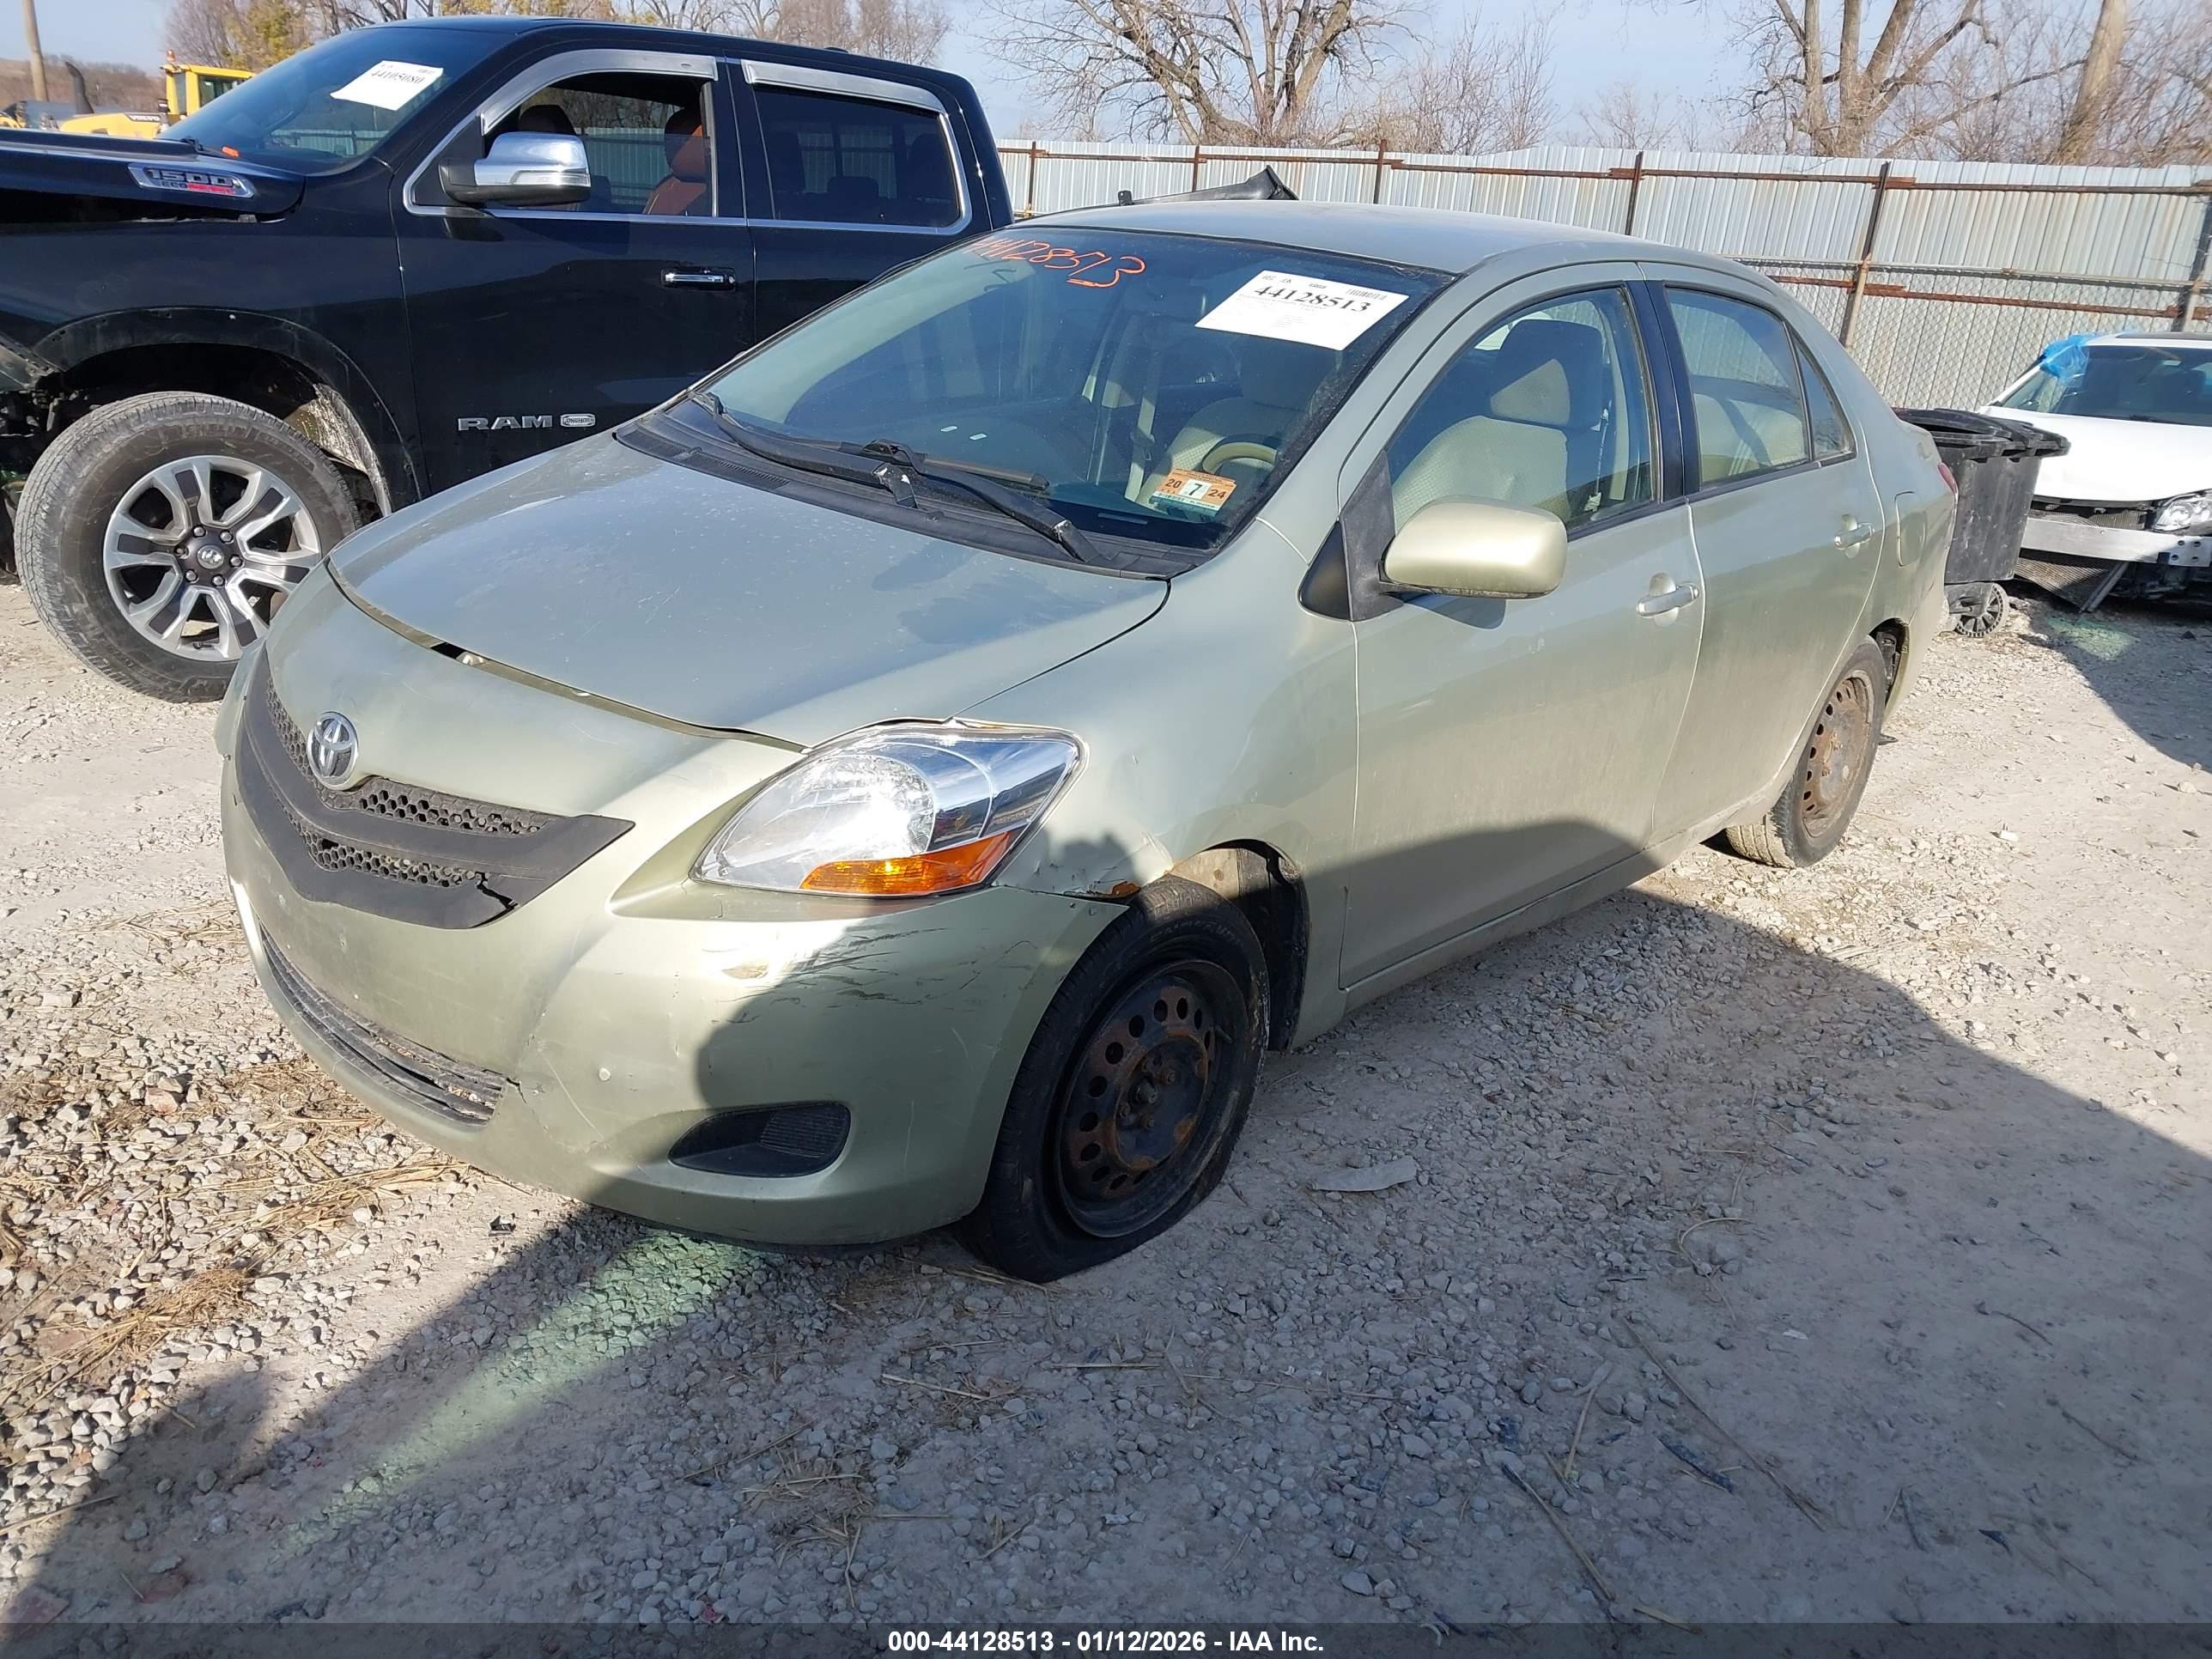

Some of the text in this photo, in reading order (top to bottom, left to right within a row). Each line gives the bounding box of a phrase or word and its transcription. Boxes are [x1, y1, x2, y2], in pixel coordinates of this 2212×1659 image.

[146, 168, 234, 187] 1500
[1254, 286, 1371, 312] 44128513
[458, 415, 553, 431] RAM
[1165, 479, 1182, 489] 20
[1188, 483, 1203, 496] 7
[1207, 489, 1226, 499] 24
